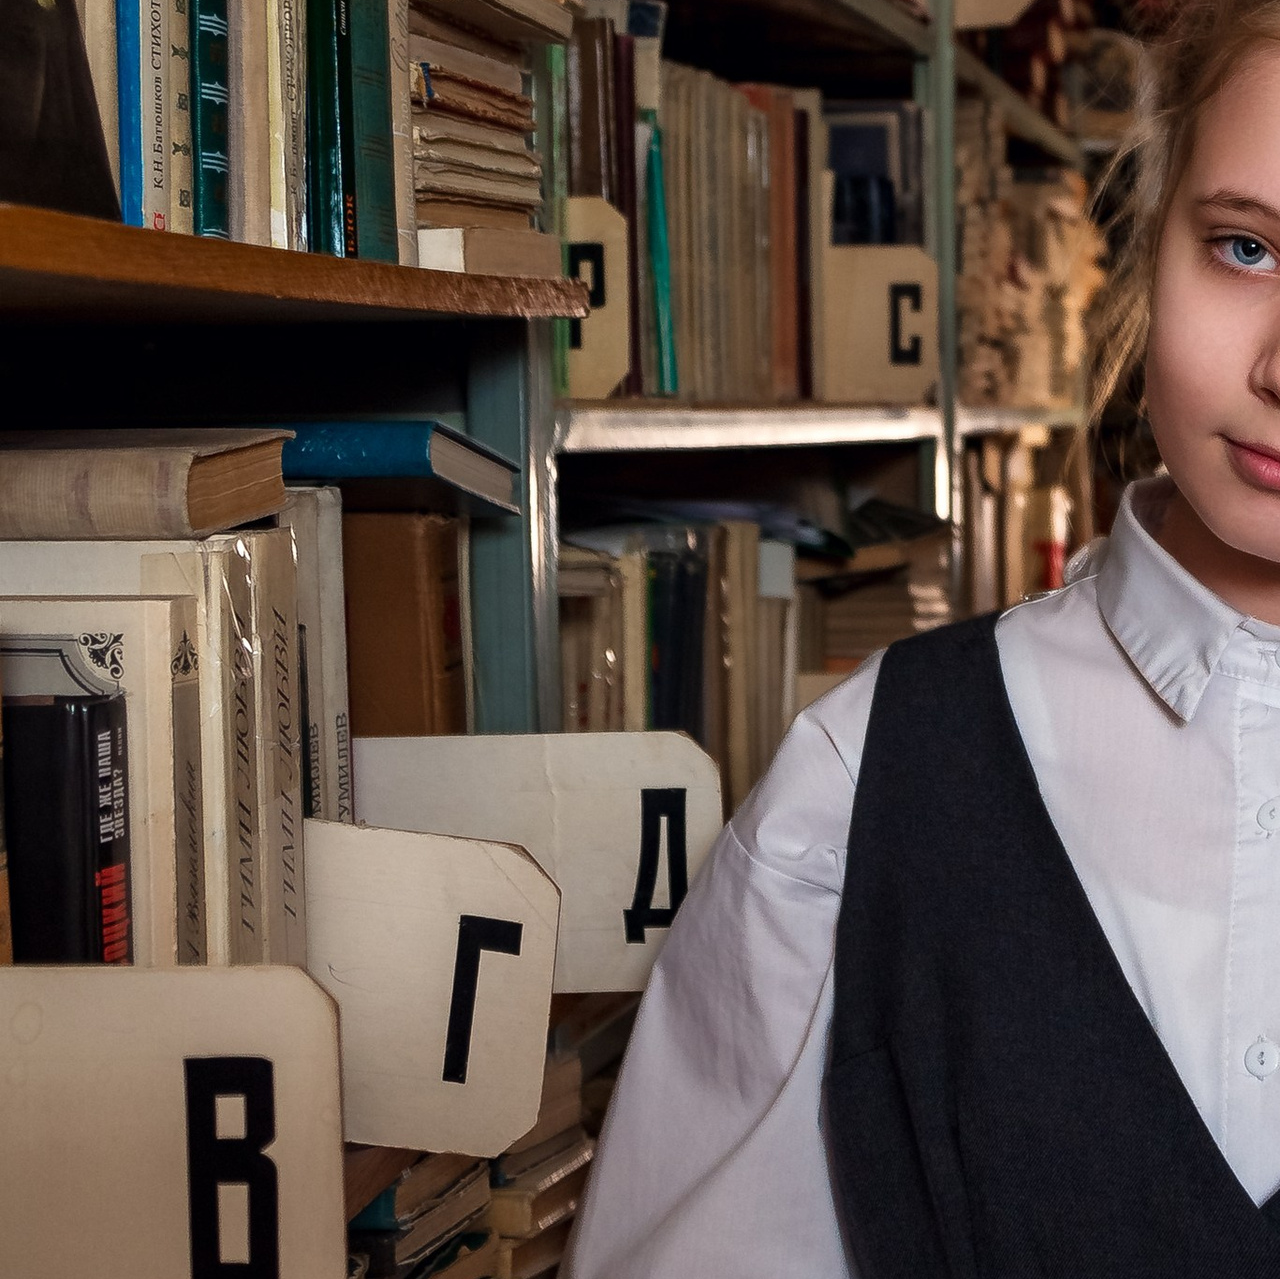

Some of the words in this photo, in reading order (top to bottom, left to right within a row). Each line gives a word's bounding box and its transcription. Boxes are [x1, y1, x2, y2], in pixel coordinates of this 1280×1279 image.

[338, 0, 347, 36] Стихи
[151, 75, 165, 190] К.Н.Батюшков
[345, 193, 356, 255] БЛОК
[888, 282, 923, 366] С
[271, 605, 295, 781] ЛЮБВИ
[96, 729, 113, 779] НАША
[98, 782, 113, 807] ЖЕ
[112, 768, 126, 839] ЗВЕЗДА?
[334, 712, 351, 822] УМИЛЕВ
[99, 808, 115, 844] ГДЕ
[235, 798, 256, 937] ГИМН
[280, 789, 298, 922] ГИМН
[623, 787, 688, 944] Д
[95, 863, 129, 965] ОЦКИЙ
[442, 914, 523, 1084] Г
